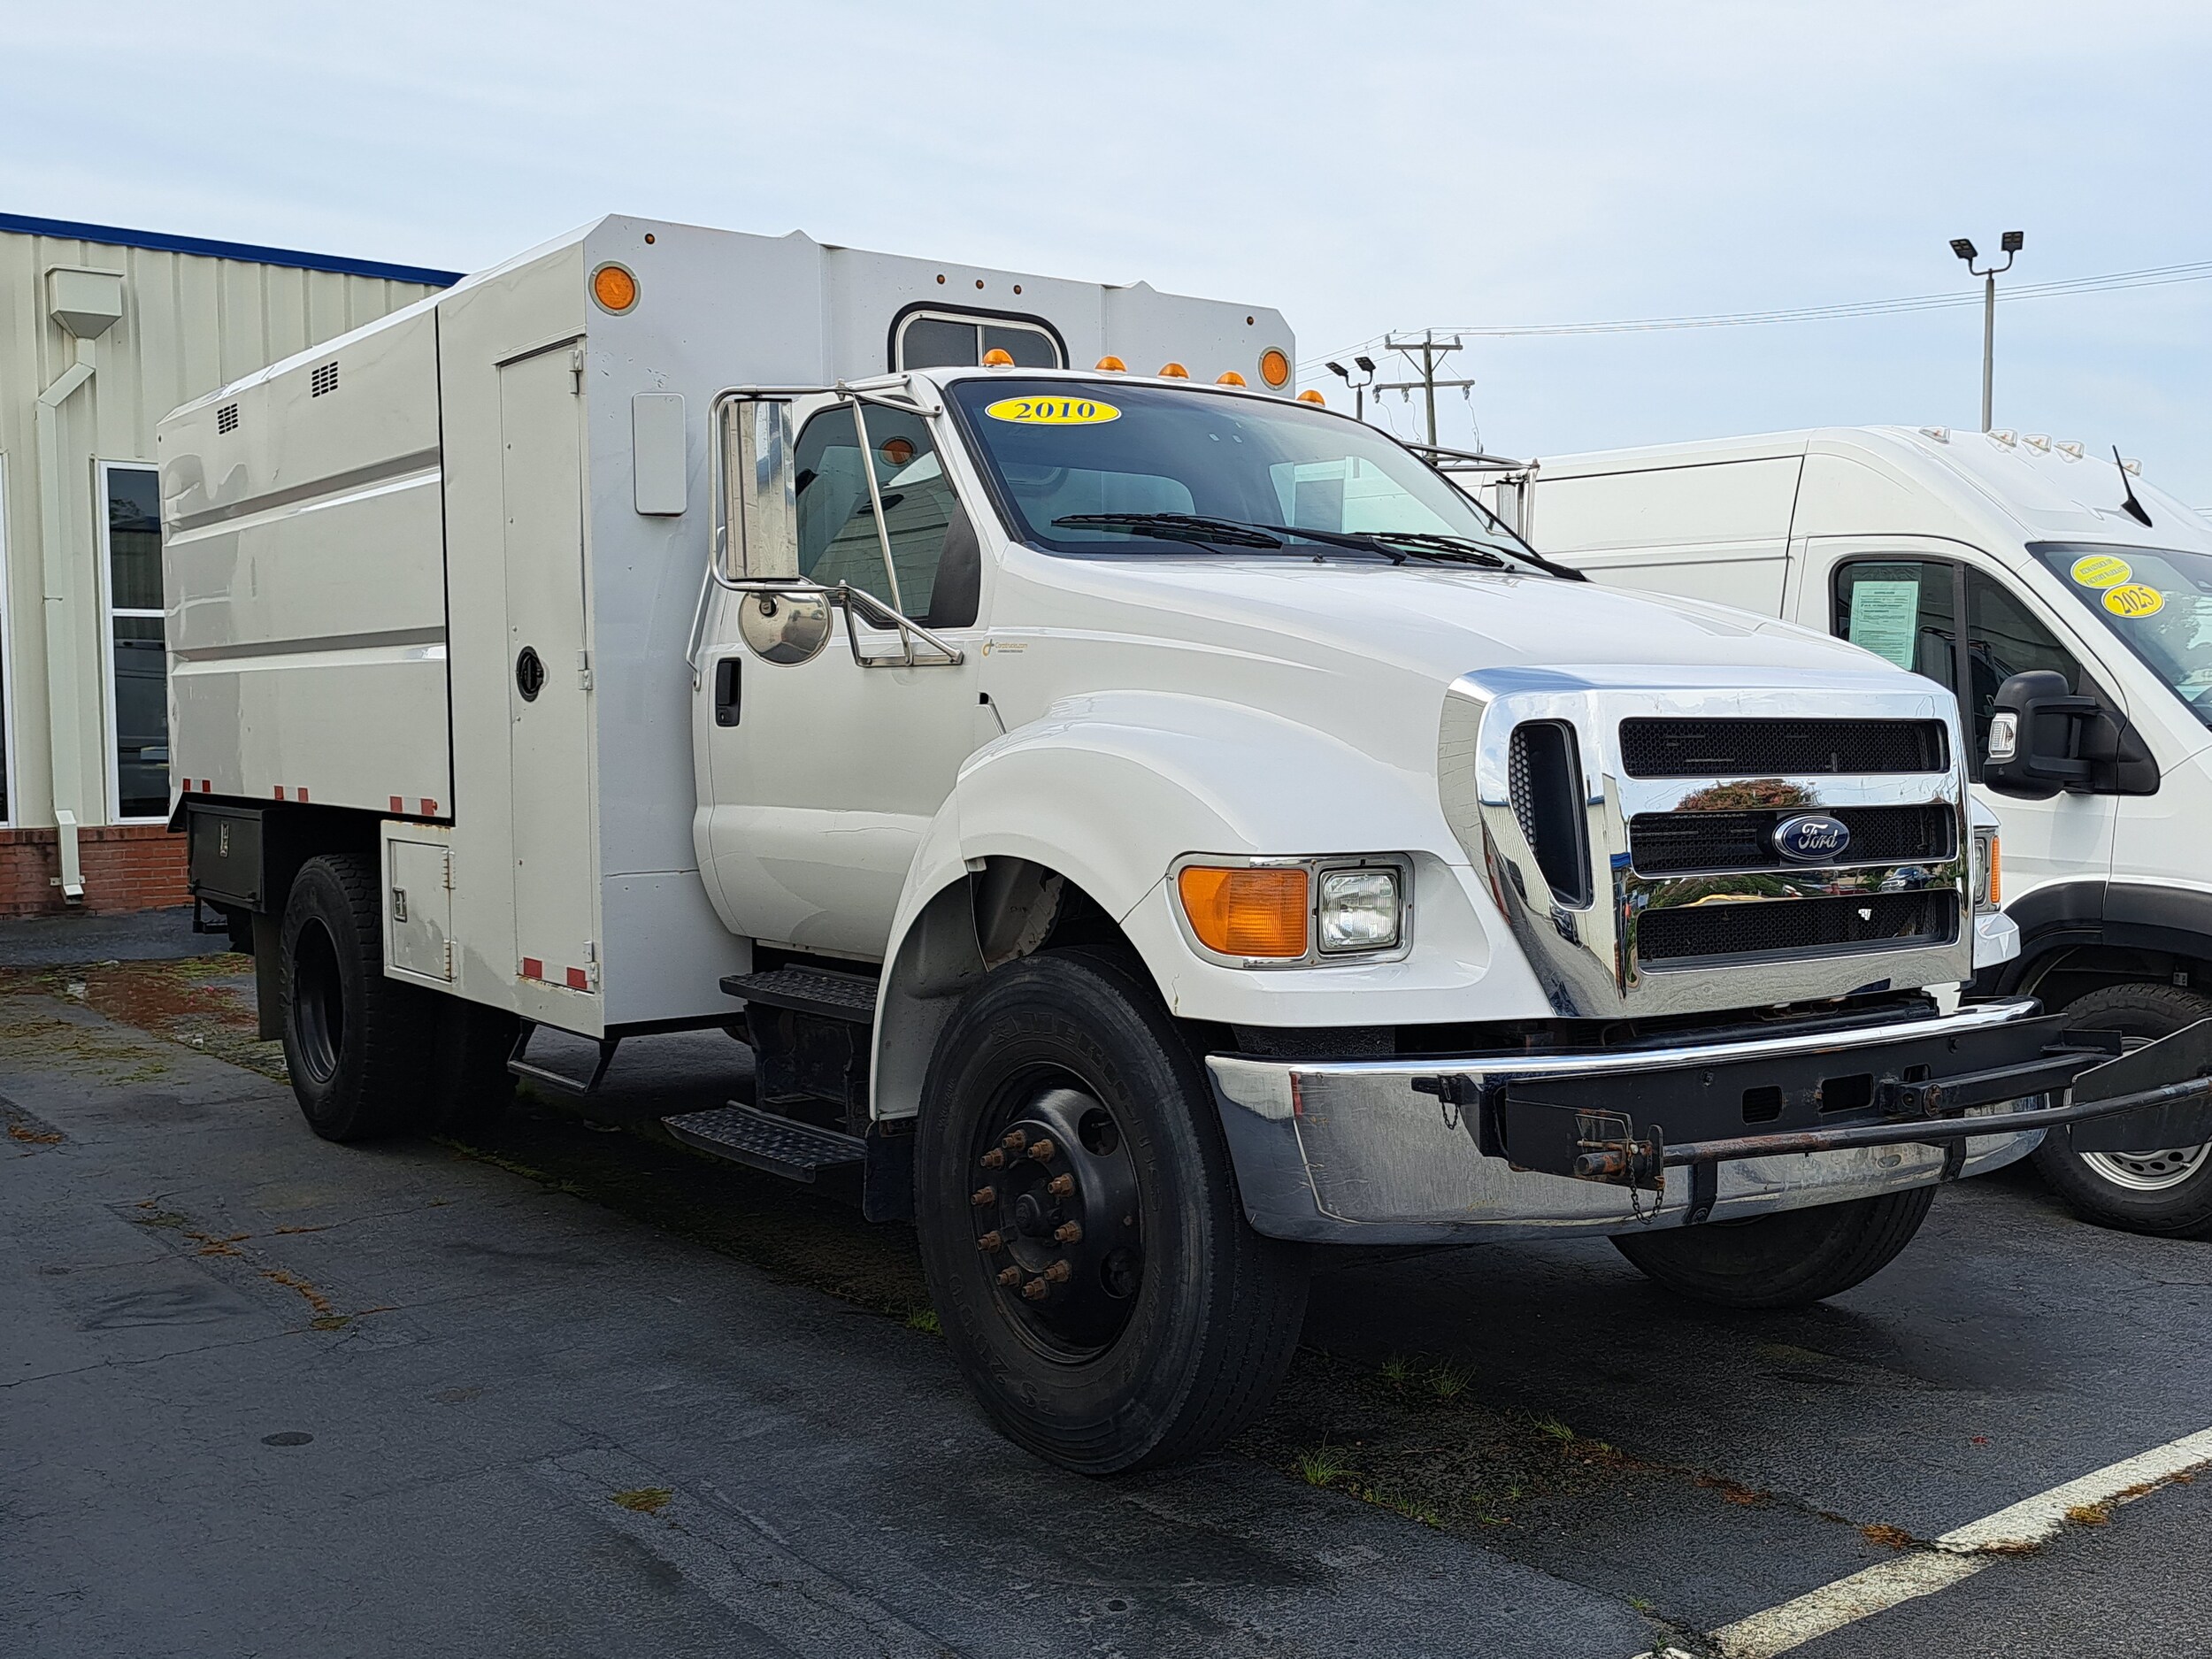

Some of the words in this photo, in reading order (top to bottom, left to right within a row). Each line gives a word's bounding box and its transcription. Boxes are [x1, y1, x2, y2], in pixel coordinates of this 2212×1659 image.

[1013, 402, 1095, 419] 2010
[2085, 572, 2108, 585] FACTORY
[2104, 565, 2128, 577] WARRANTY
[2112, 587, 2154, 614] 2025
[1798, 823, 1839, 849] Ford
